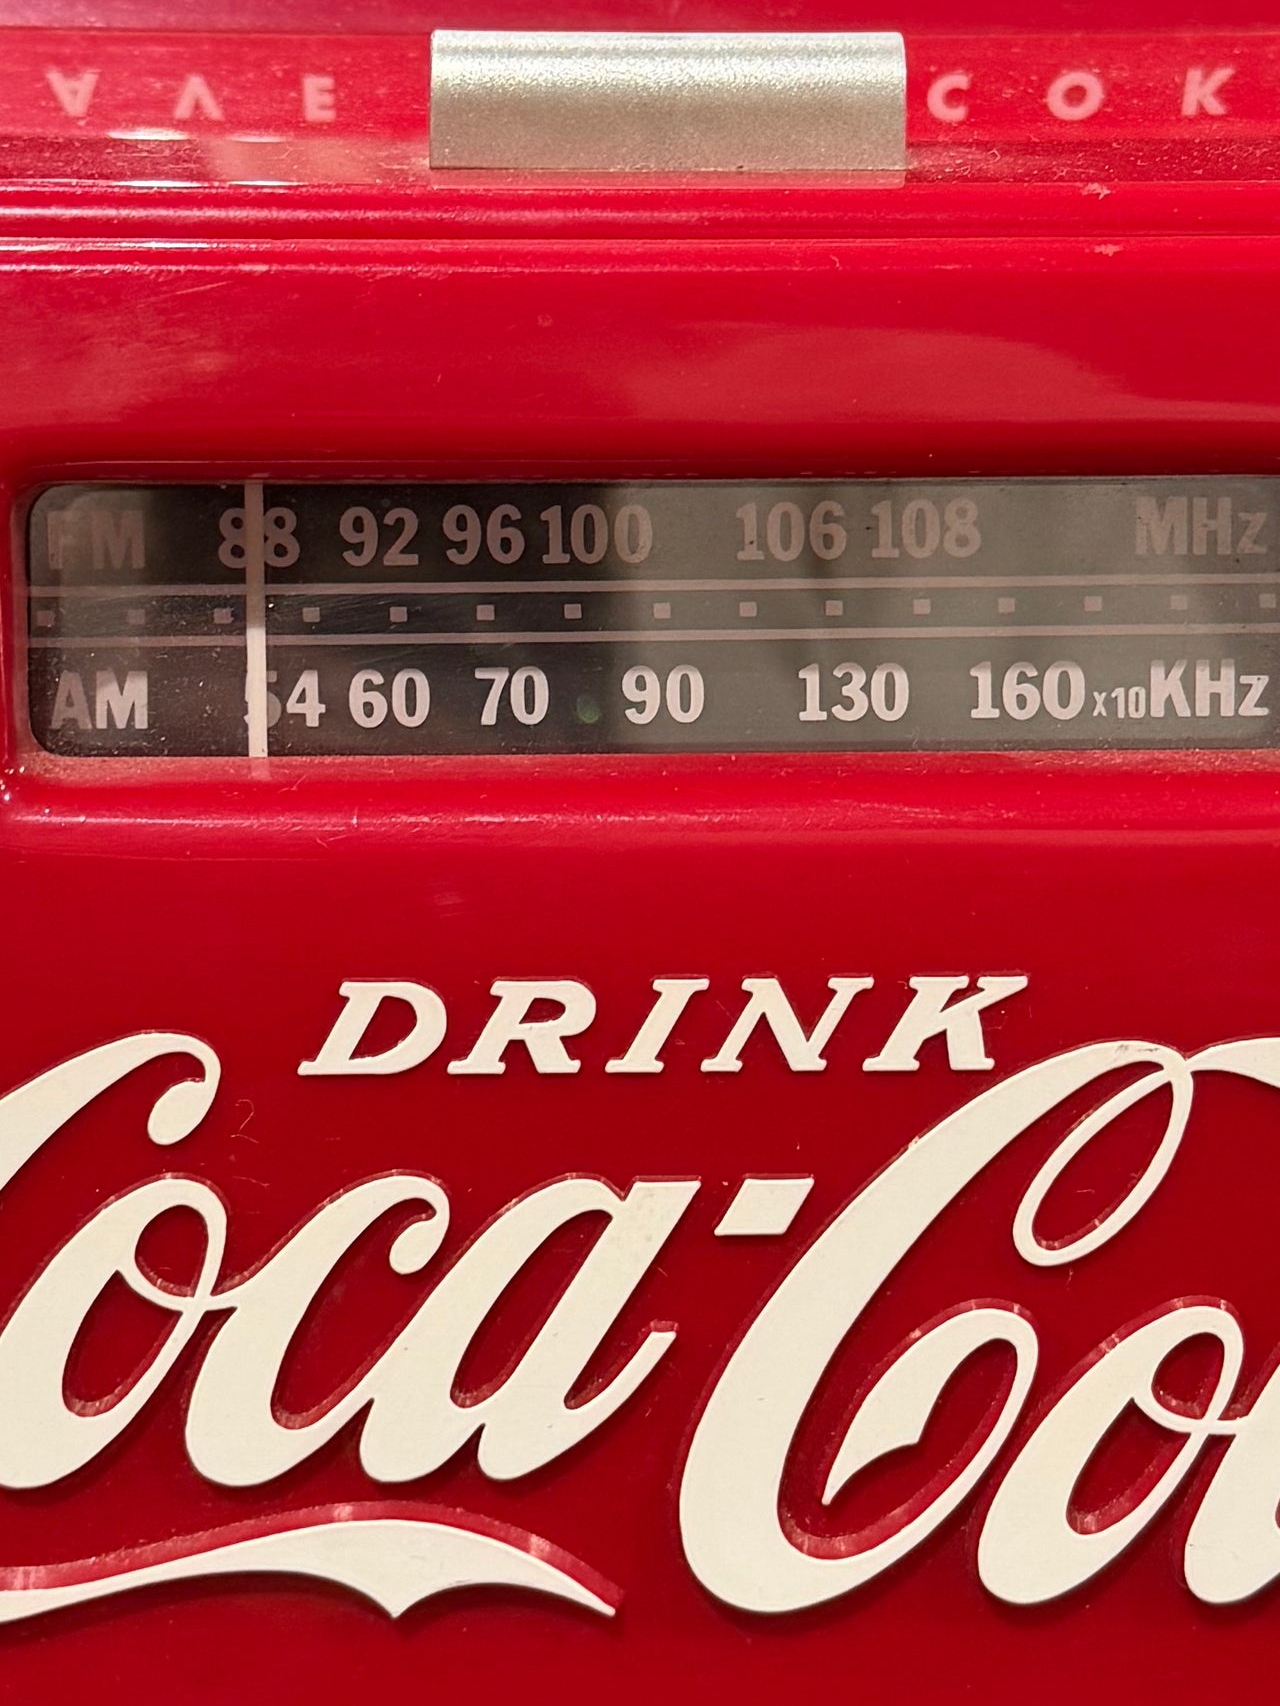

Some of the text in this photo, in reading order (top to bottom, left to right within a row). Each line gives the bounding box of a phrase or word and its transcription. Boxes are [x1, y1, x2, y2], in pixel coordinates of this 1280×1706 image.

[46, 495, 1268, 570] FM 88 92 96 100 106 108 MHz
[51, 669, 149, 730] AM
[348, 667, 430, 729] 60
[474, 665, 549, 726] 70
[622, 664, 705, 725] 90
[798, 661, 909, 722] 130
[970, 660, 1086, 721] 160
[1149, 659, 1270, 718] KHz
[298, 975, 1029, 1075] DRINK
